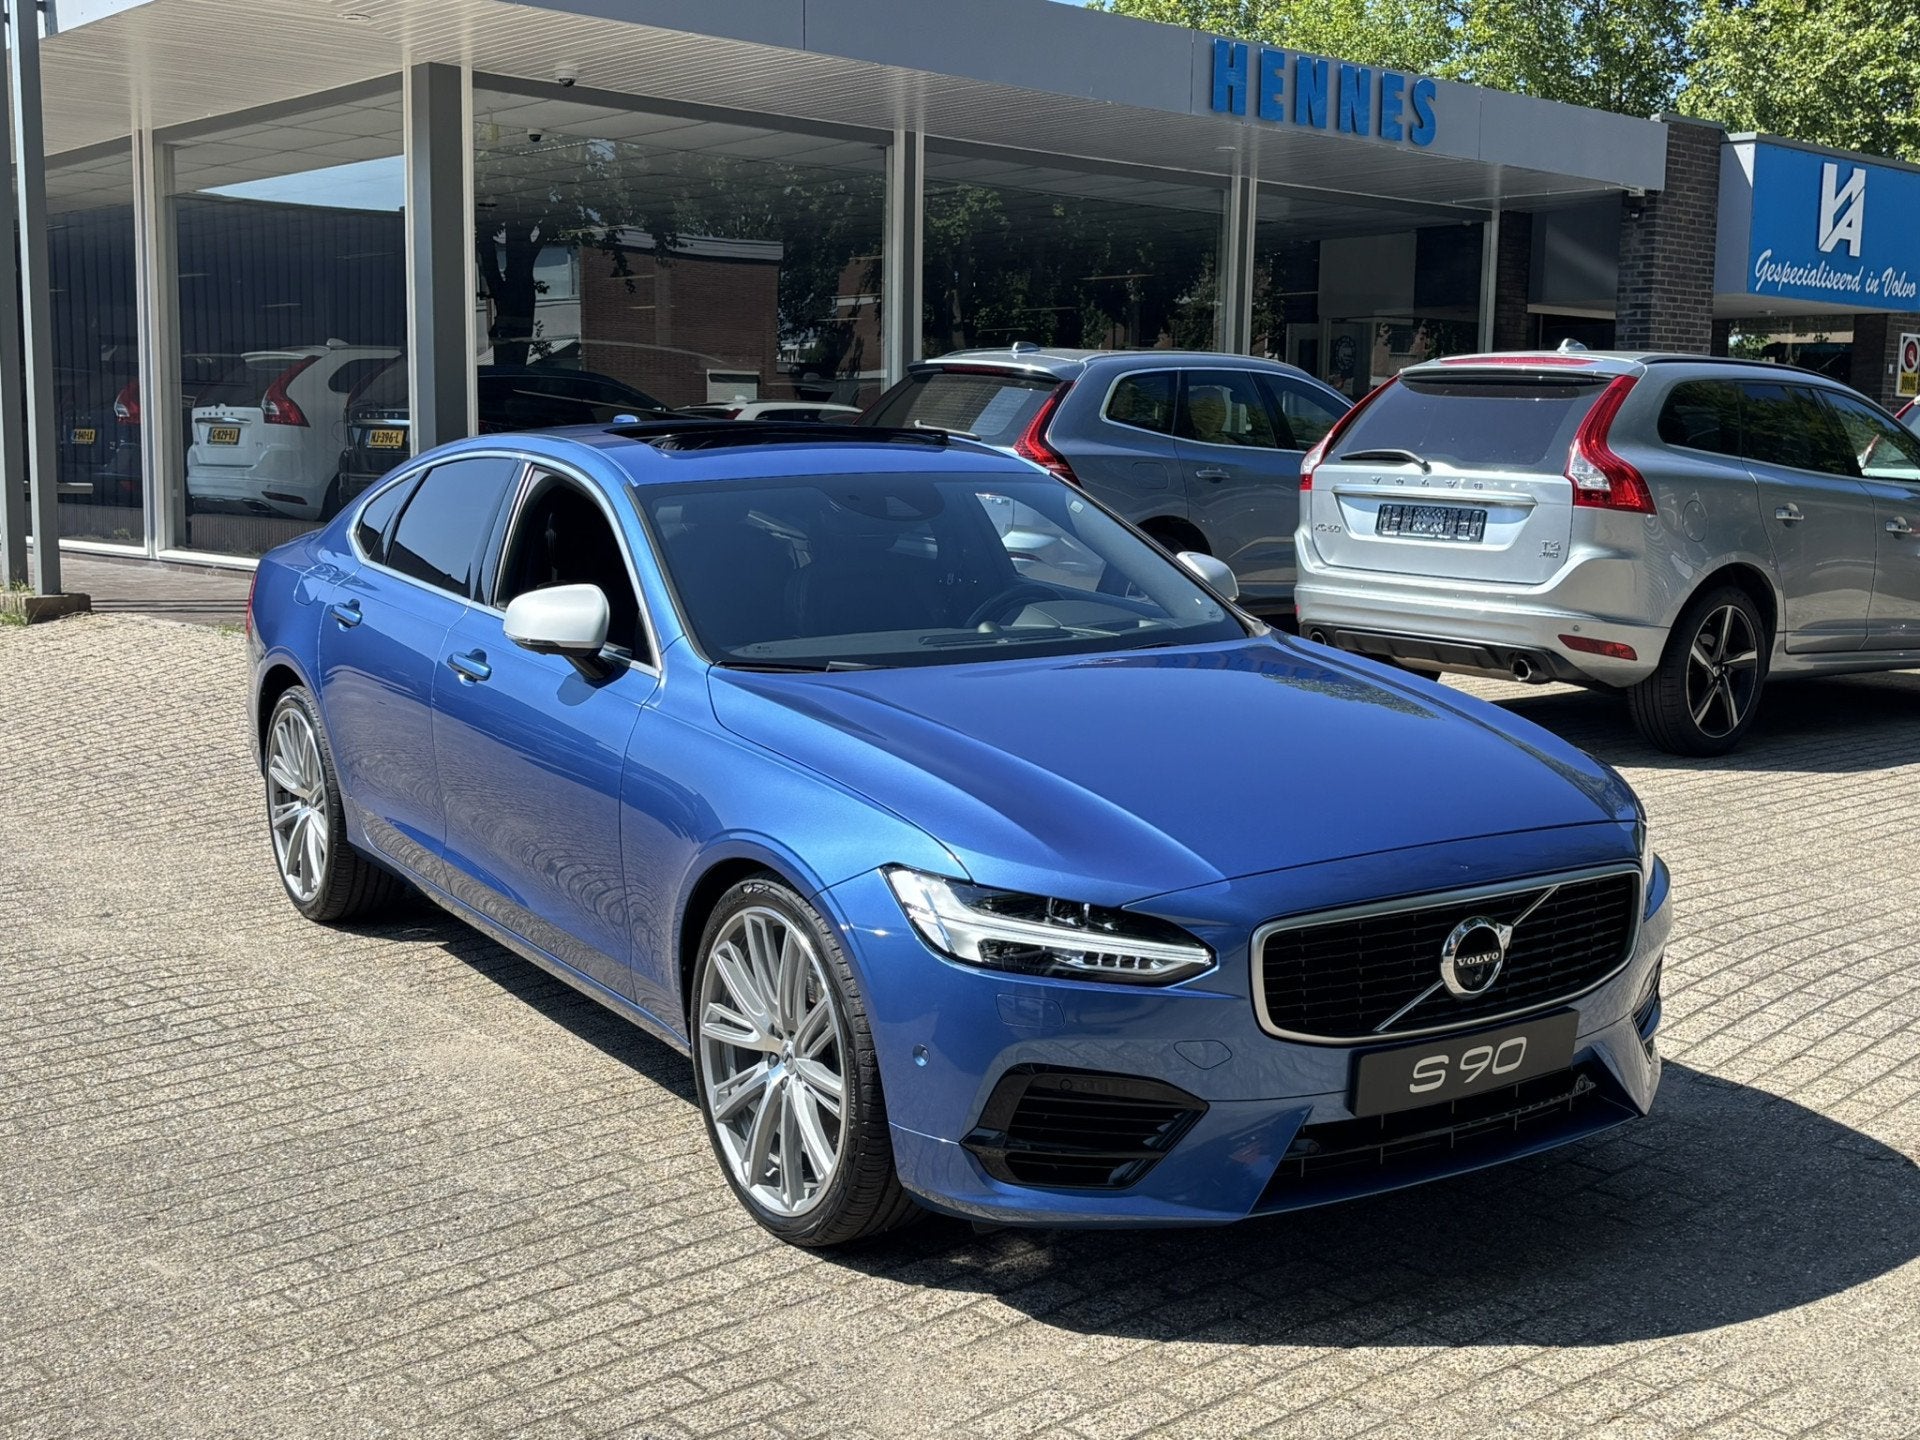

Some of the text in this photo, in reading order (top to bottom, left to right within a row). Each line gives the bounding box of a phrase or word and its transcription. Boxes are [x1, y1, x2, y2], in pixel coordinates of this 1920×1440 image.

[1212, 38, 1437, 147] HENNES
[1755, 248, 1917, 299] Gespecialiseerd in Volvo
[1371, 475, 1484, 490] VOLVO
[1456, 951, 1500, 967] VOLVO
[1409, 1036, 1528, 1094] S 90
